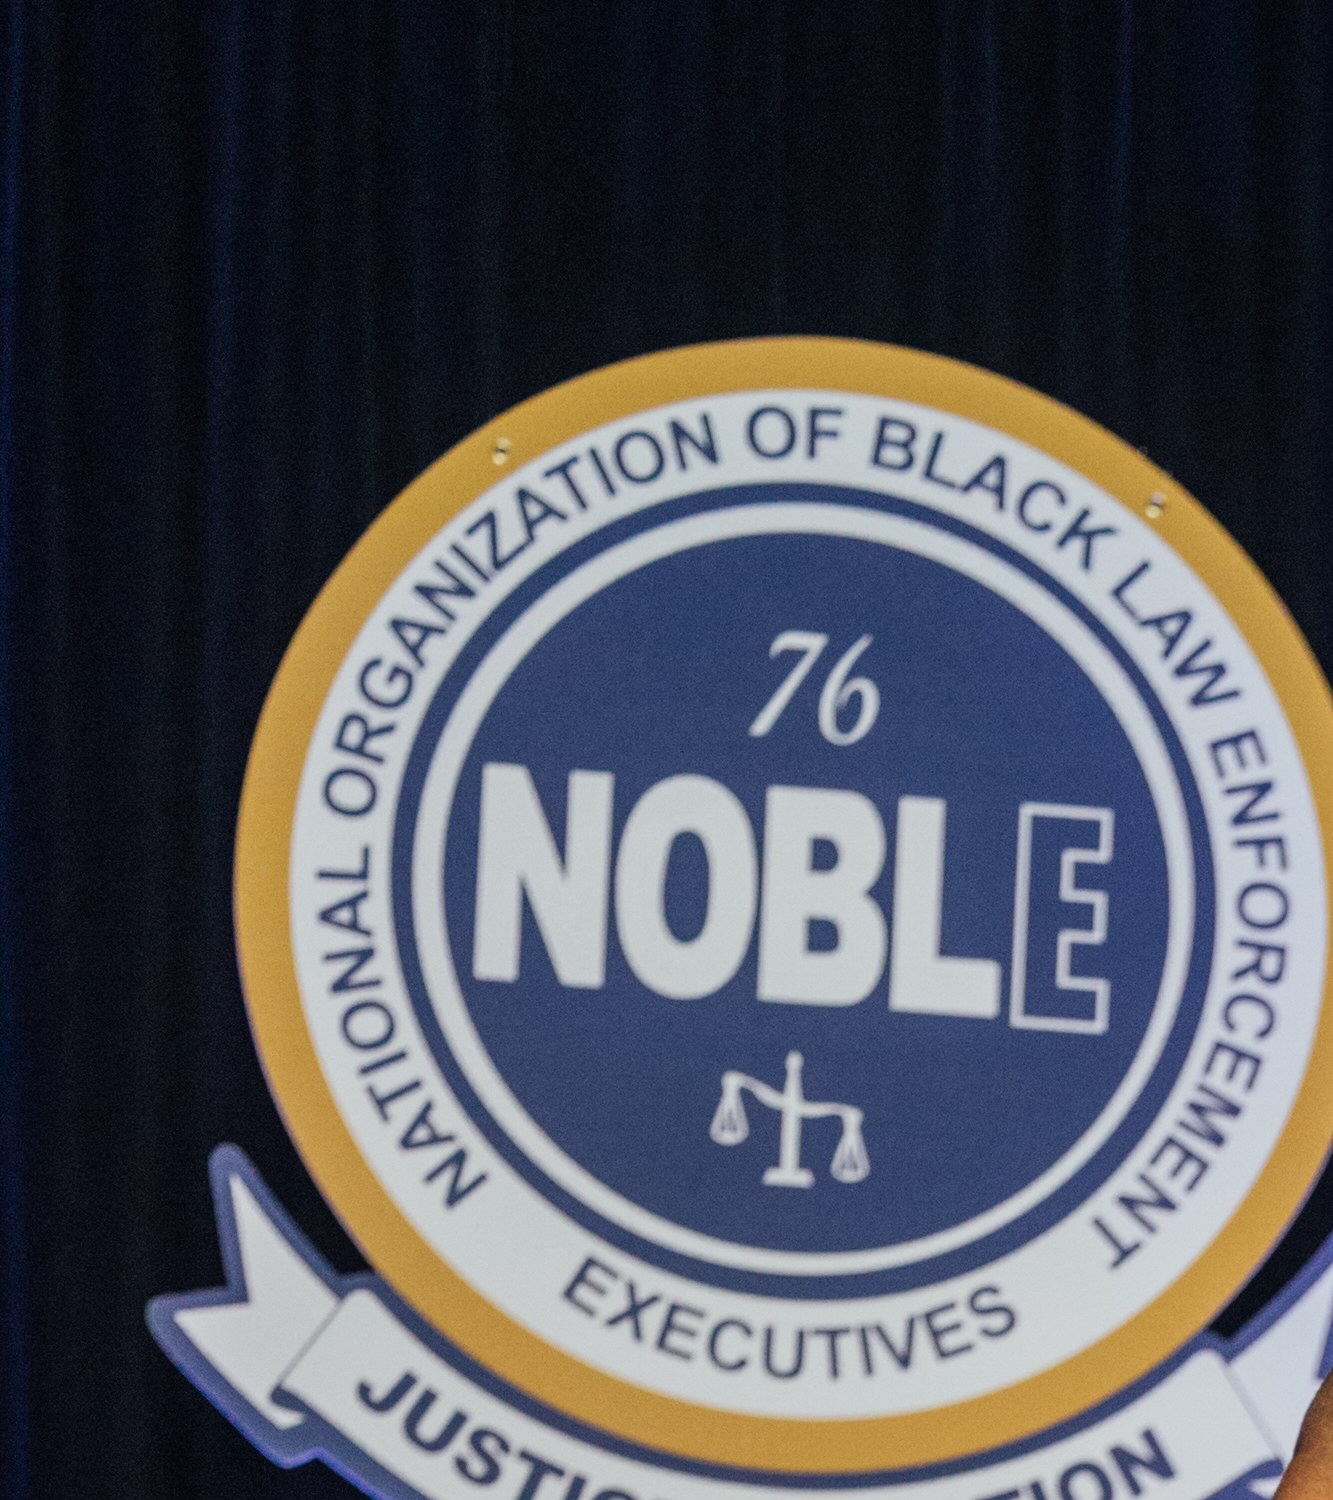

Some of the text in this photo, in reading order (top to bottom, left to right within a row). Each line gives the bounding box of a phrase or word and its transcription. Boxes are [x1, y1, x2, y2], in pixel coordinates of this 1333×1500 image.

[749, 630, 880, 746] 76
[315, 404, 1291, 1269] NATIONAL ORGANIZATION OF BLACK LAW ENFORCEMENT
[472, 762, 1115, 1035] NOBLE
[562, 1255, 1017, 1381] EXECUTIVES
